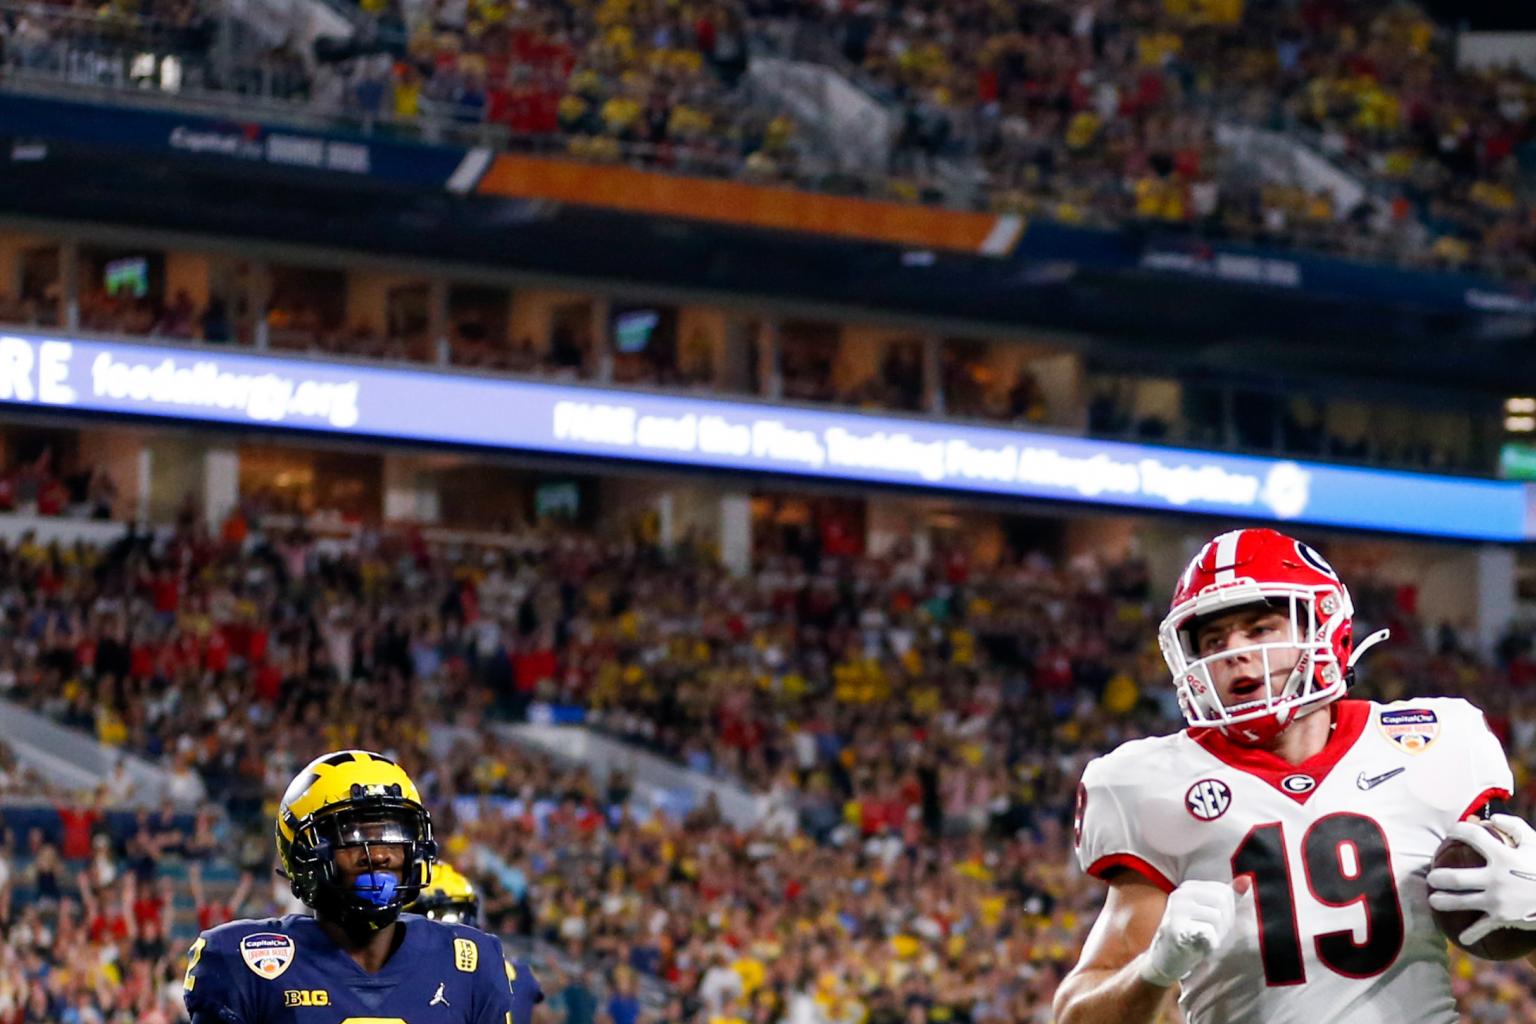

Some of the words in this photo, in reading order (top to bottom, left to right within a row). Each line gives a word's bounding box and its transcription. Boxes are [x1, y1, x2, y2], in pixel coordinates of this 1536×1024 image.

[1188, 780, 1229, 819] SEC
[1283, 775, 1314, 793] G
[1230, 811, 1405, 987] 19
[183, 936, 206, 991] 2
